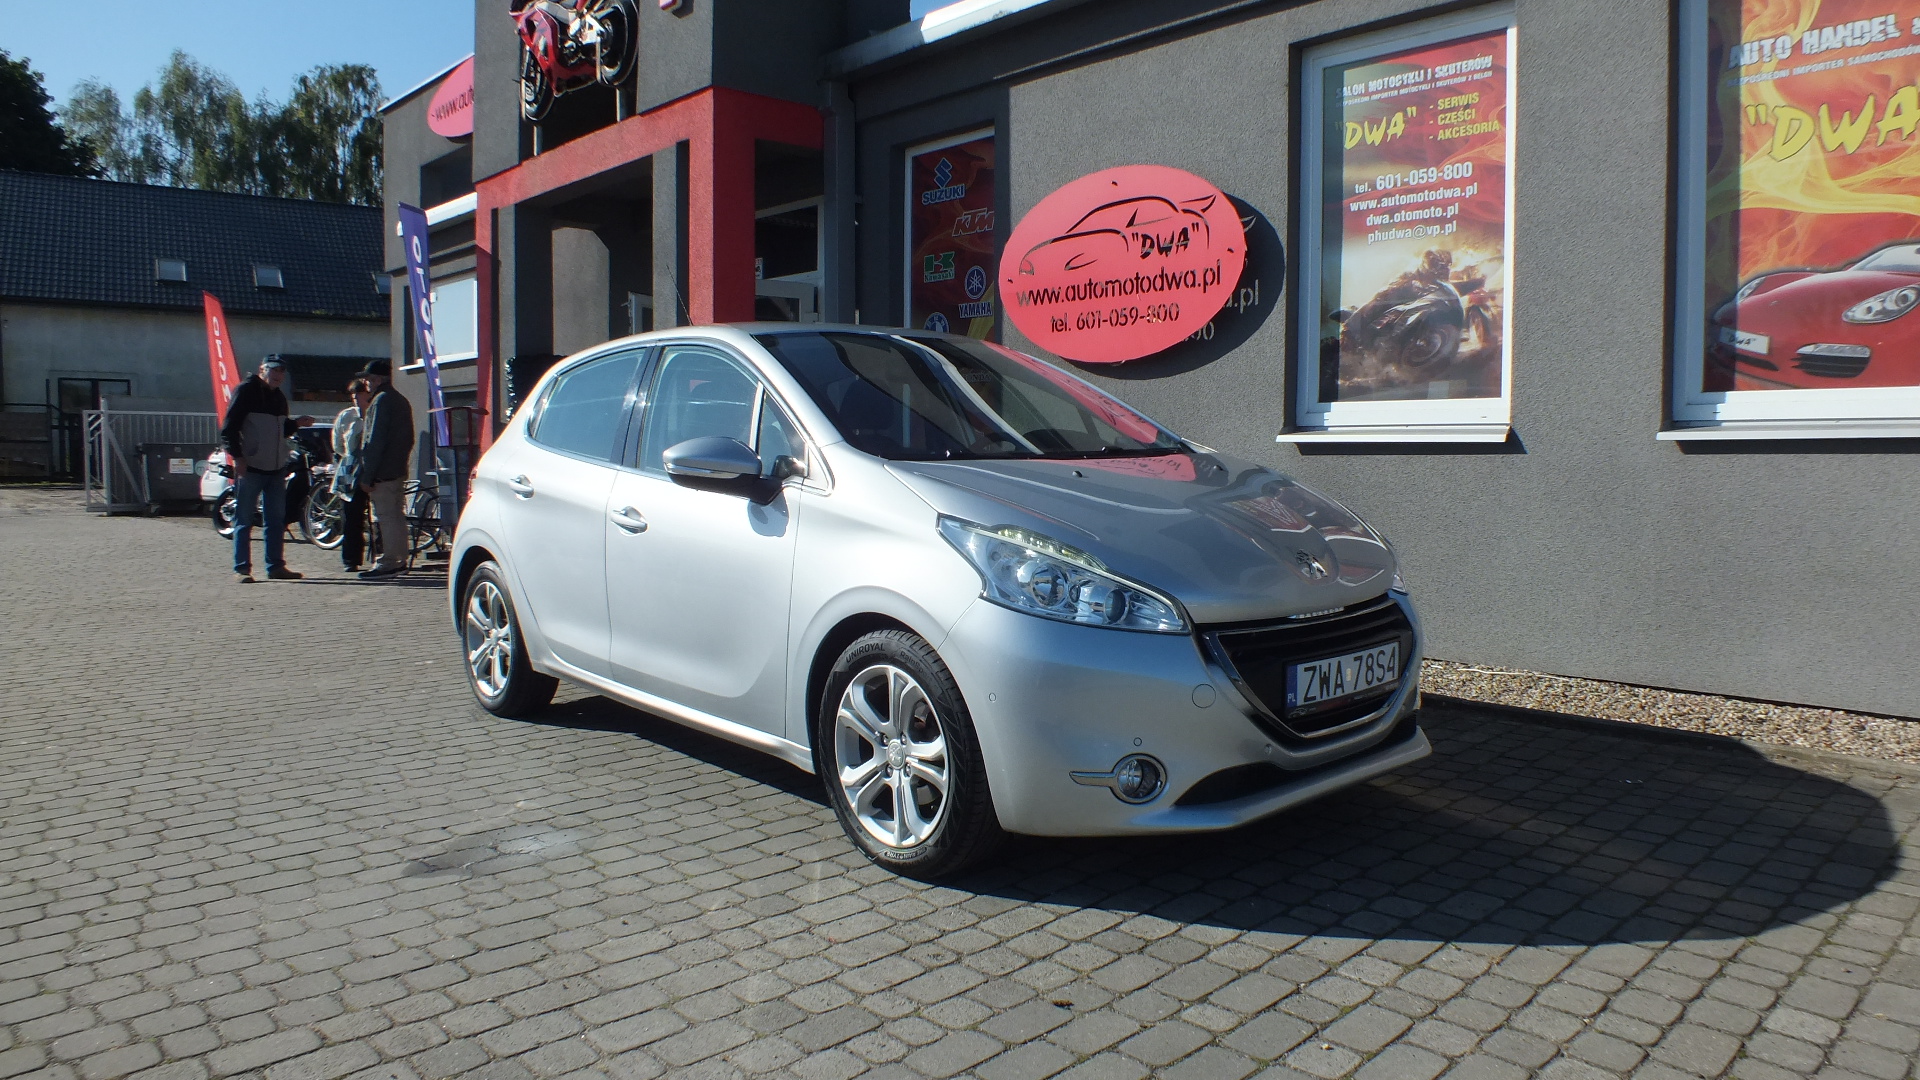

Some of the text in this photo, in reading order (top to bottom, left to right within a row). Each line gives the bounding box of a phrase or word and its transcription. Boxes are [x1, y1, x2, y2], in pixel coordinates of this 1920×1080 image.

[1728, 35, 1792, 69] AUTO
[1802, 14, 1902, 55] HANDEL
[1336, 53, 1493, 98] SALON MOTOCYKLI I SKUTERÓW
[1793, 58, 1844, 76] IMPORTER
[1437, 92, 1480, 110] SERWIS
[1437, 108, 1476, 126] CZĘŚCI
[1437, 120, 1500, 141] AKCESORIA
[1355, 161, 1473, 194] tel. 601-059-800
[922, 184, 965, 205] SUZUKI
[1350, 182, 1478, 212] www.automotodwa.pl
[952, 207, 994, 237] KTM
[1366, 202, 1459, 226] dwa.otomoto.pl
[1131, 221, 1200, 260] "DWA"
[1367, 220, 1457, 245] phudwa@vp.pl
[924, 268, 954, 283] Kawasaki
[1016, 258, 1222, 308] www.automotodwa.pl
[958, 301, 993, 318] YAMAHA
[1051, 312, 1072, 333] tel.
[1076, 302, 1180, 332] 601-059-800
[846, 642, 886, 664] UNIROYAL
[1303, 646, 1396, 703] ZWA 78S4
[1287, 692, 1296, 704] PL
